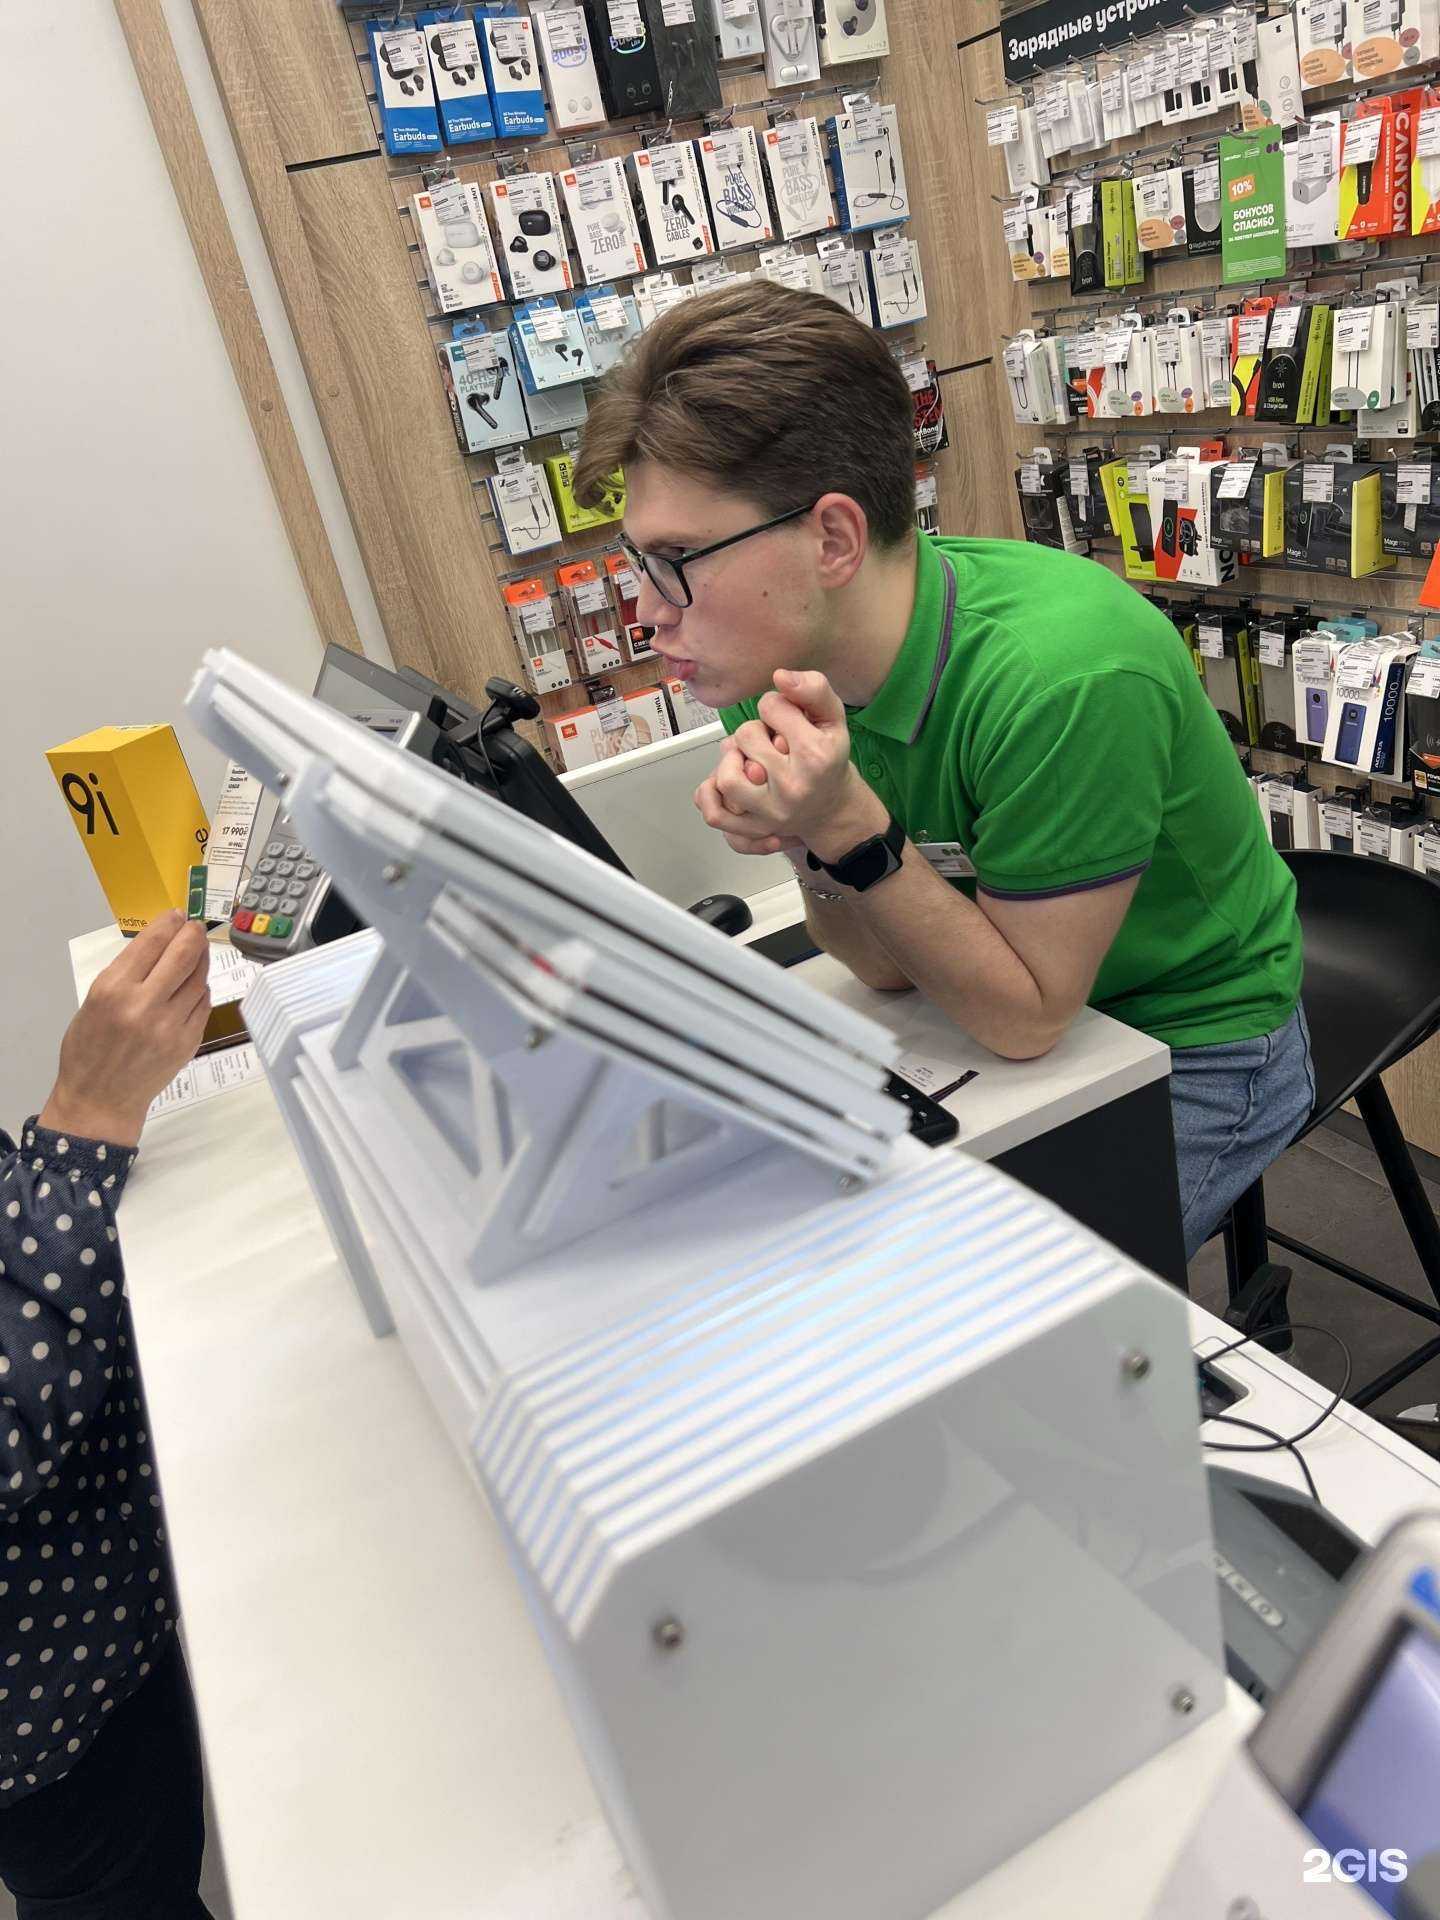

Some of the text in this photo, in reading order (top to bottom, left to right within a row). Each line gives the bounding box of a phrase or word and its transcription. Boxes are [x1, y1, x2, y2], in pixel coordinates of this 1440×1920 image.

[1008, 14, 1092, 61] Зарядные
[449, 123, 480, 133] Earbuds
[504, 116, 534, 125] Earbuds
[393, 132, 427, 141] Earbuds
[1393, 112, 1410, 232] CANYON
[723, 184, 752, 205] BASS
[785, 176, 813, 196] BASS
[1231, 180, 1253, 196] 10%
[1233, 204, 1274, 220] БОНУСОВ
[665, 215, 688, 233] ZERO
[1232, 216, 1275, 232] СПАСИБО
[667, 228, 690, 242] CABLES
[591, 234, 620, 255] ZERO
[1384, 681, 1399, 723] 10000
[62, 772, 120, 835] 9i
